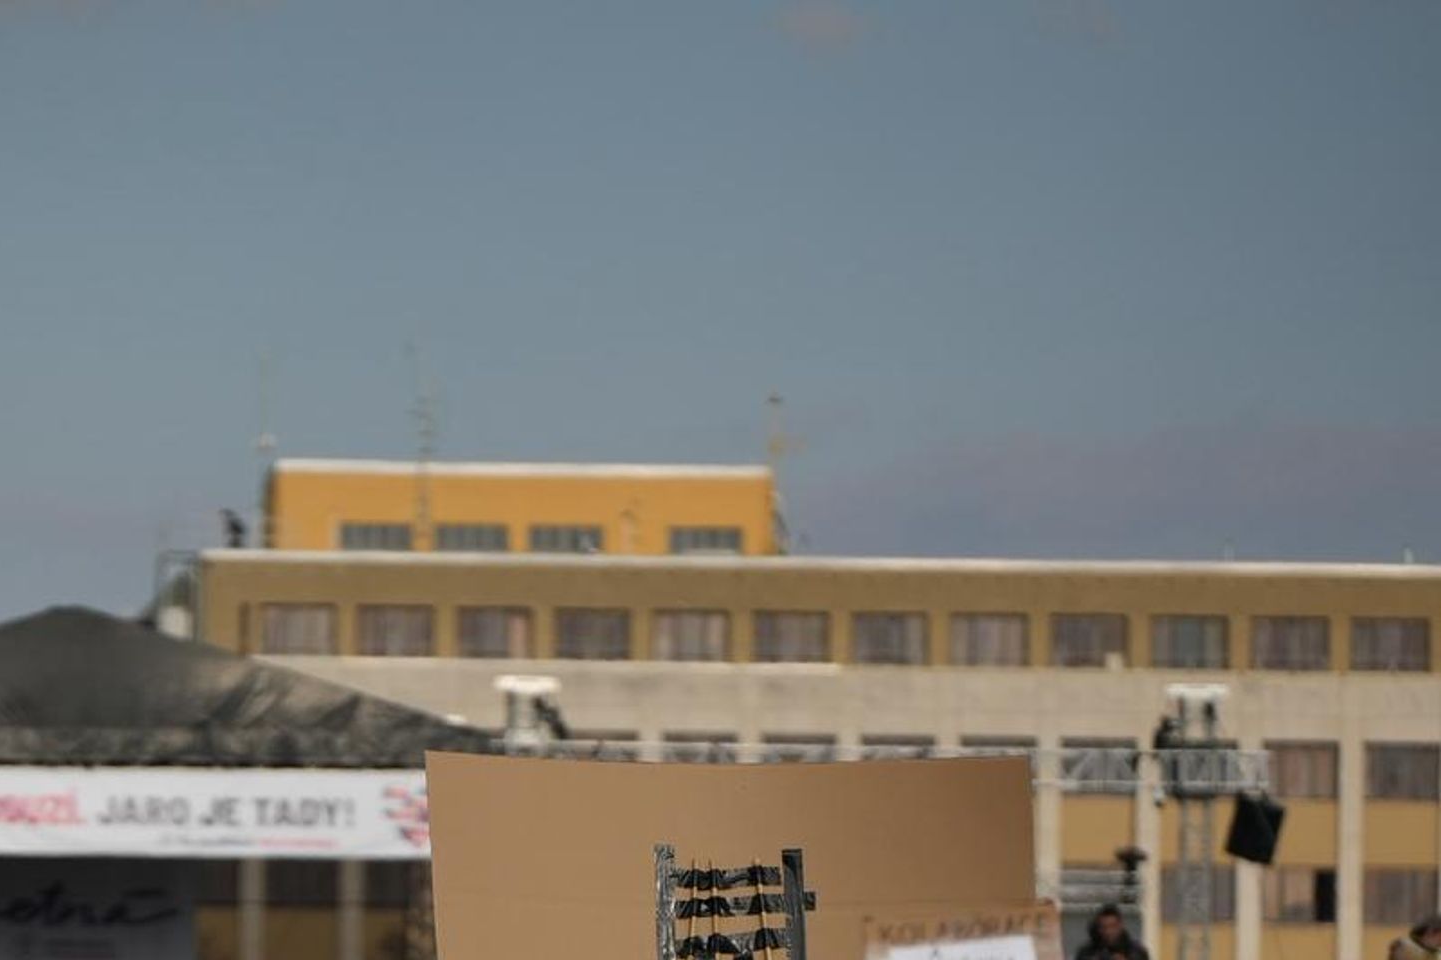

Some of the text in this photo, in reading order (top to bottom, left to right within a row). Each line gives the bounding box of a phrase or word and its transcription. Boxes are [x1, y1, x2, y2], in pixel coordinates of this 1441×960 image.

[97, 797, 190, 825] JARO
[199, 797, 241, 826] JE
[252, 796, 356, 827] TADY!
